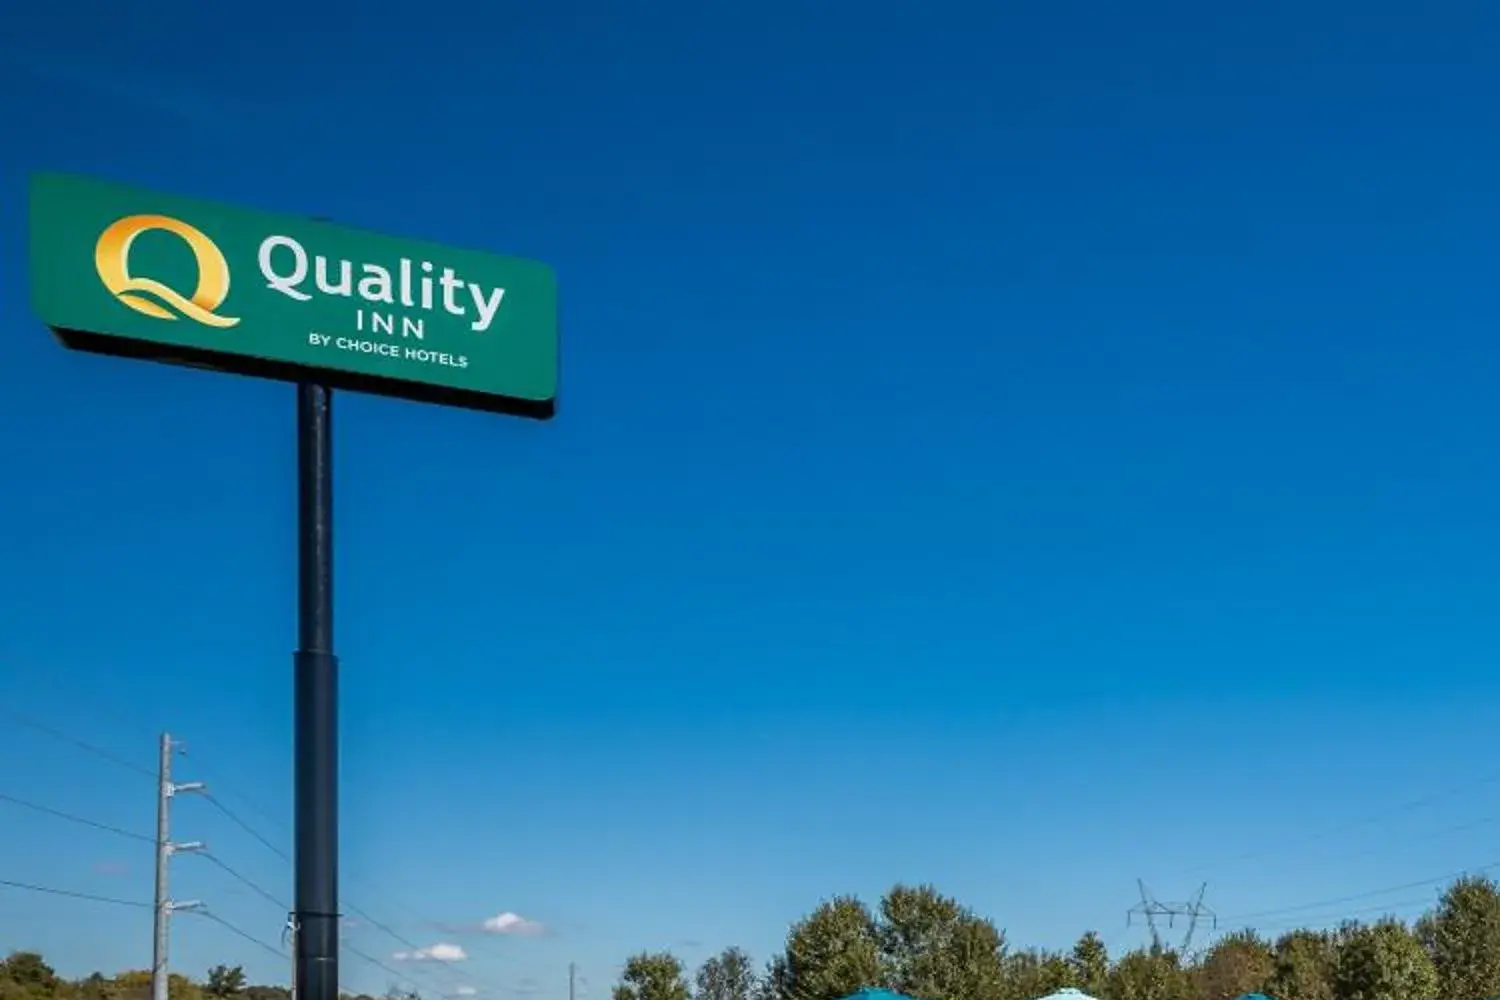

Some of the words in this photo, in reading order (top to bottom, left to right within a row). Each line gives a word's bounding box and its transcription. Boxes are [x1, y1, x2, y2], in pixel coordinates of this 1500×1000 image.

[95, 214, 240, 327] Q
[258, 235, 505, 331] Quality
[309, 333, 331, 345] BY
[336, 337, 400, 357] CHOICE
[405, 347, 468, 367] HOTELS
[357, 309, 424, 339] INN
